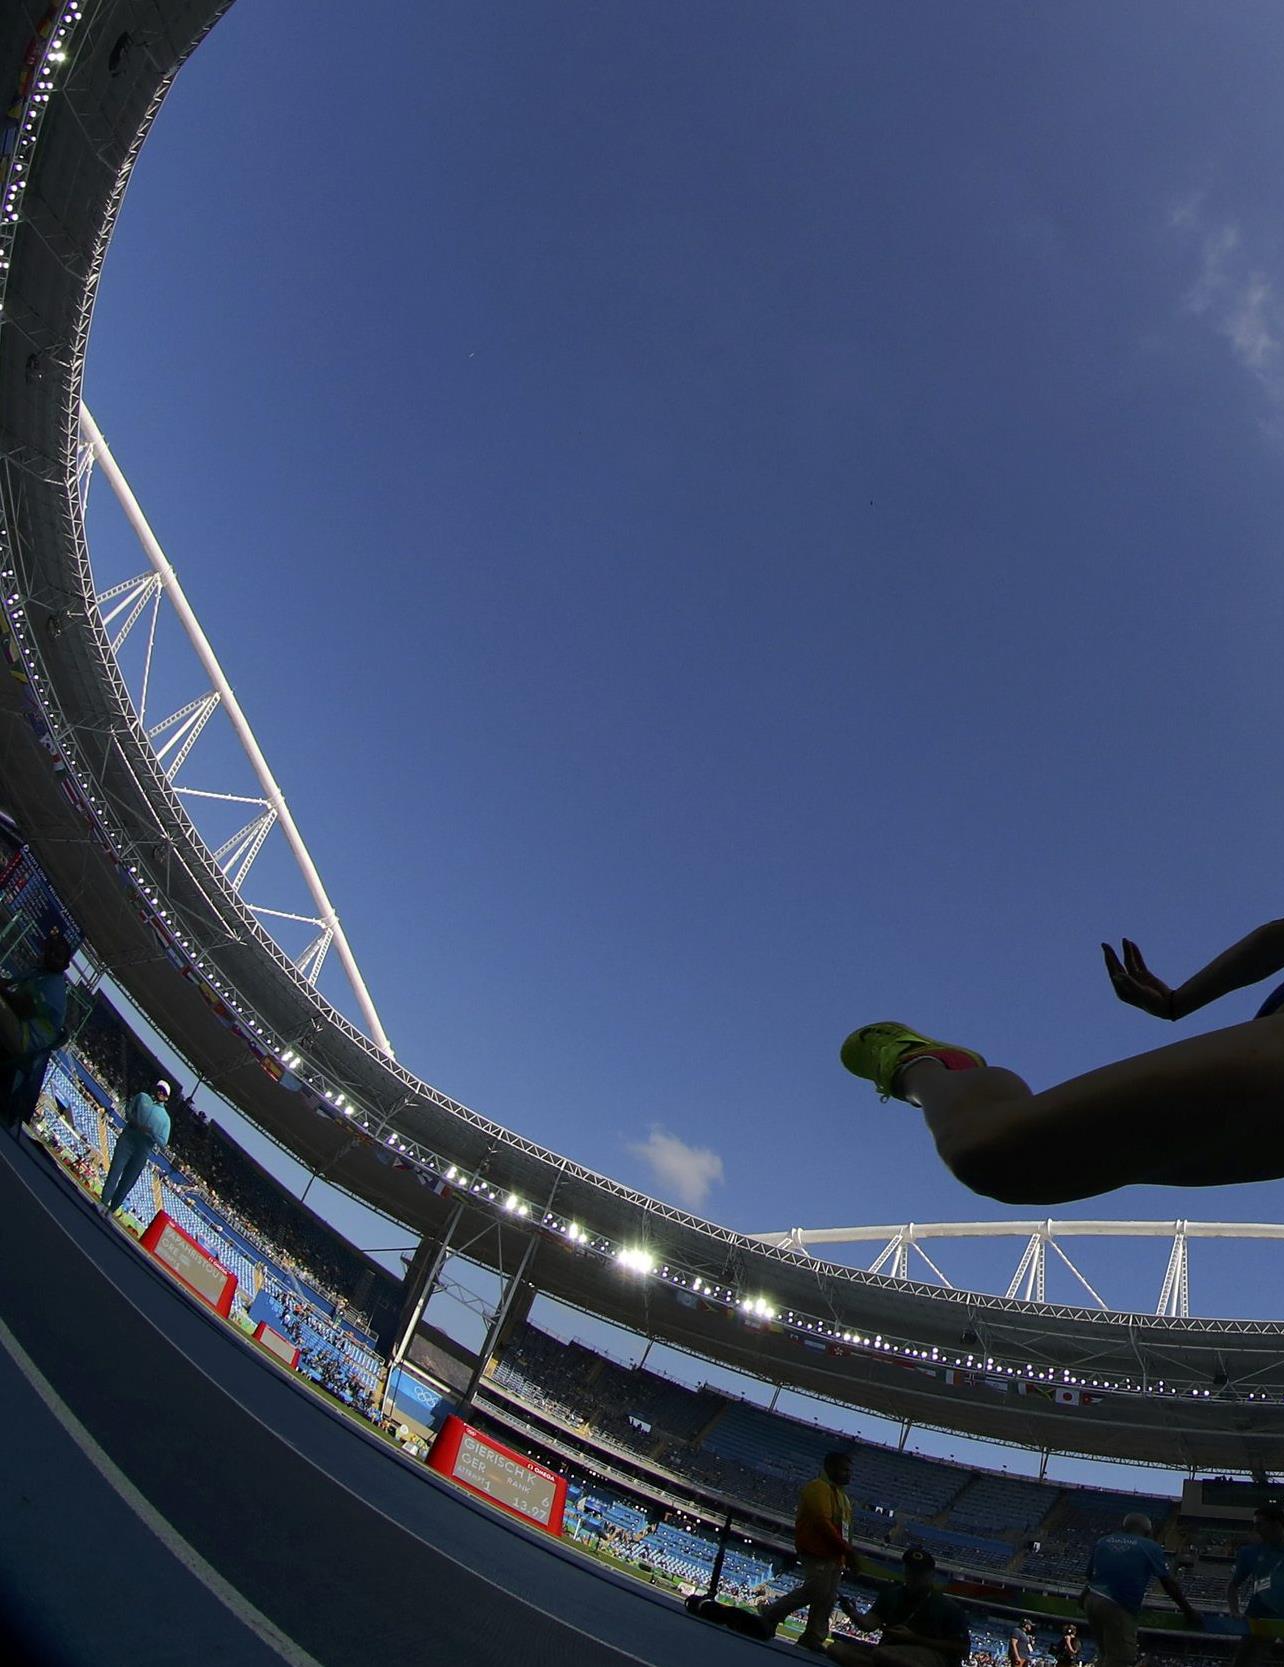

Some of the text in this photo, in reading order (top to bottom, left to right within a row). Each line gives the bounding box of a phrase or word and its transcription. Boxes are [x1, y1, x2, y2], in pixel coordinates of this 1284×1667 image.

[461, 1453, 486, 1472] GER
[464, 1438, 537, 1485] GIERISCH K
[534, 1466, 555, 1482] OMEGA
[506, 1477, 550, 1508] RANK 6
[513, 1498, 547, 1519] 13.97
